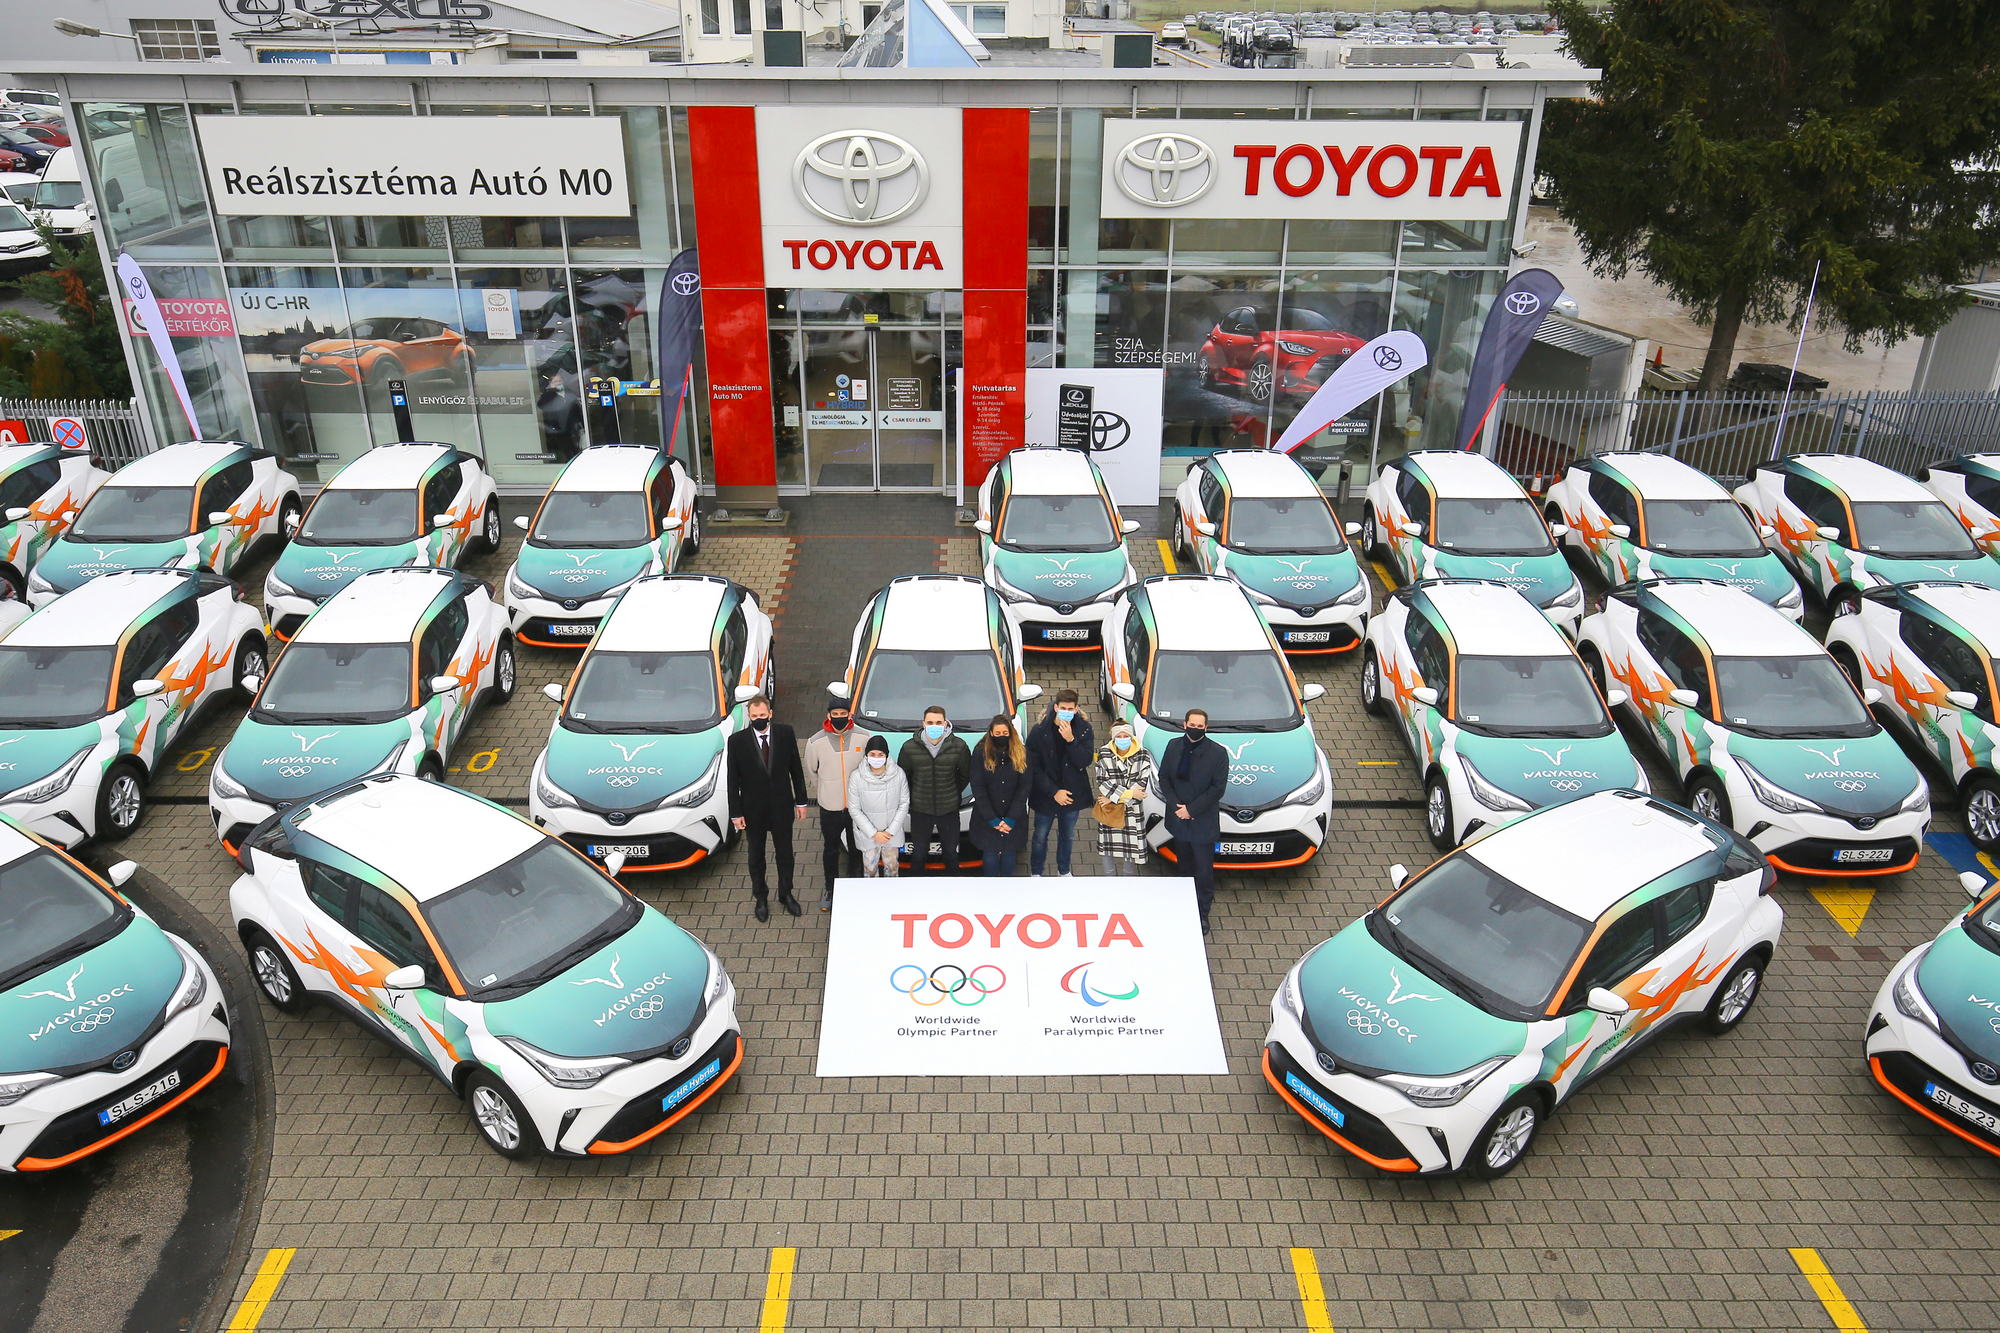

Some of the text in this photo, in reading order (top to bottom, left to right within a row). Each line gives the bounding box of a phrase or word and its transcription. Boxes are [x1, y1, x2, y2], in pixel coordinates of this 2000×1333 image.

[1233, 143, 1502, 198] TOYOTA
[222, 165, 612, 196] Reálszisztéma Autó M0
[783, 240, 943, 271] TOYOTA
[241, 292, 310, 310] ÚJ C-HR
[161, 302, 228, 315] TOYOTA
[166, 317, 231, 333] ÉRTÉKŐR
[1115, 338, 1144, 349] SZIA
[1114, 348, 1197, 364] SZÉPSÉGEM!
[395, 395, 403, 406] P
[603, 396, 611, 406] P
[827, 401, 866, 409] HYBRID
[555, 626, 594, 634] SLS-233
[1049, 630, 1087, 638] SLS-227
[1228, 764, 1276, 773] YAROCK
[596, 846, 647, 855] SLS-206
[1222, 844, 1272, 852] SLS-219
[1841, 850, 1889, 859] SLS-224
[891, 913, 1144, 949] TOYOTA
[915, 1015, 981, 1025] Worldwide
[1070, 1015, 1136, 1024] Worldwide
[897, 1027, 998, 1038] Olympic Partner
[1044, 1026, 1165, 1037] Paralympic Partner
[668, 1065, 715, 1104] C-HR Hybrid
[112, 1074, 176, 1118] SLS-216
[1291, 1079, 1339, 1120] C-HR Hybrid
[1936, 1089, 2000, 1129] SLS-23
